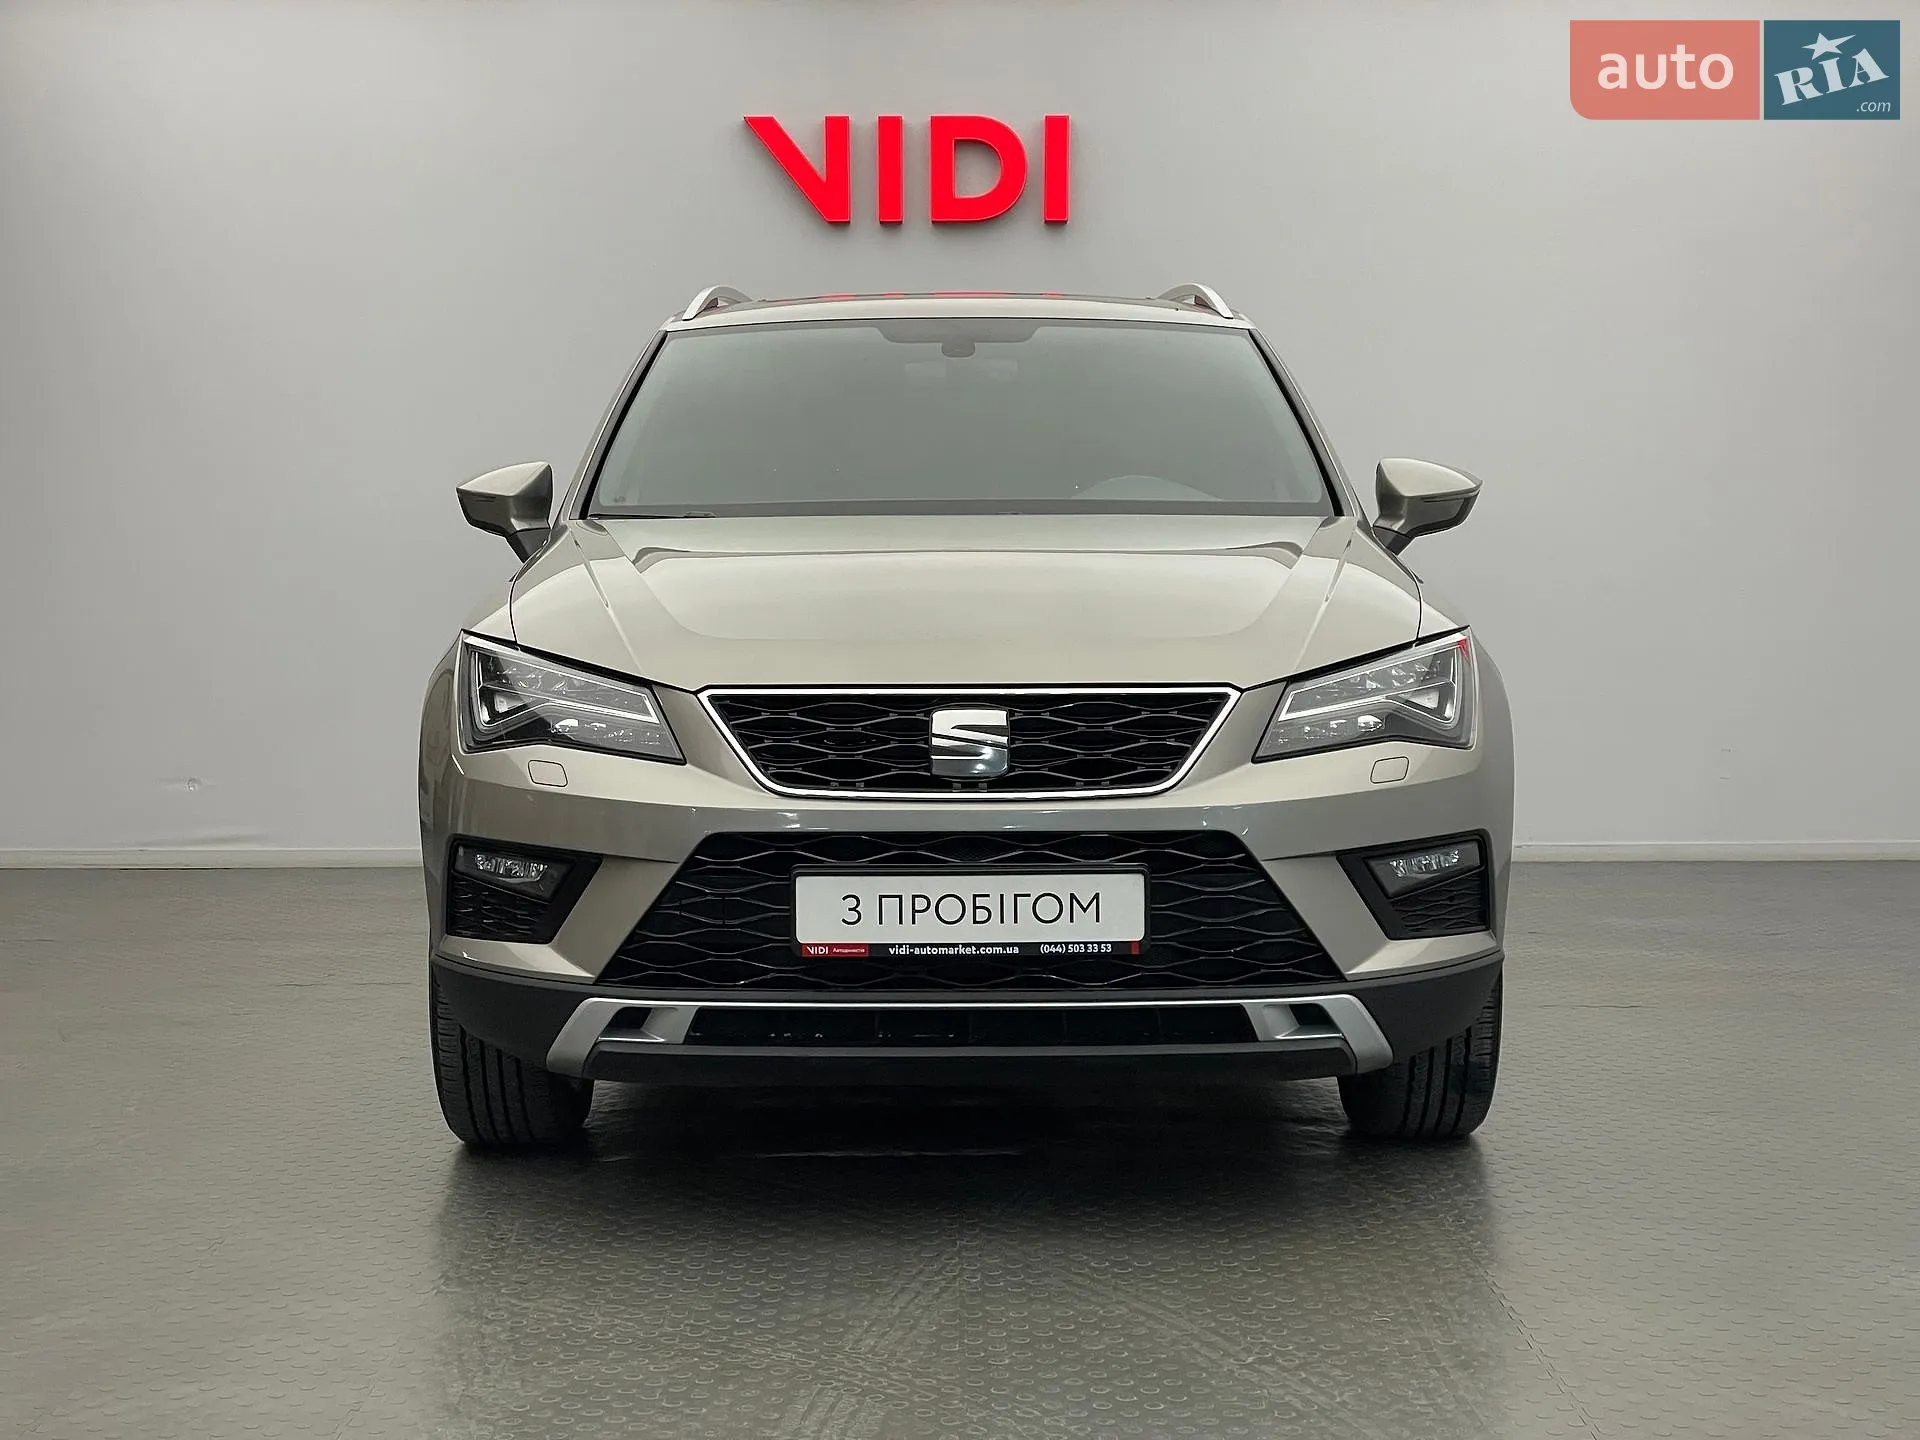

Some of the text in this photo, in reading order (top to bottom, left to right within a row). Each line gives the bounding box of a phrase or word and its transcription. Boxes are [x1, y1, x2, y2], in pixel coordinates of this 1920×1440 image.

[743, 115, 1070, 224] VIDI
[878, 891, 1101, 925] ПРОБІГОМ
[806, 946, 829, 955] VIDI
[888, 944, 1019, 955] vidi-automarket.com.ua
[1039, 943, 1112, 954] (044) 503 33 53
